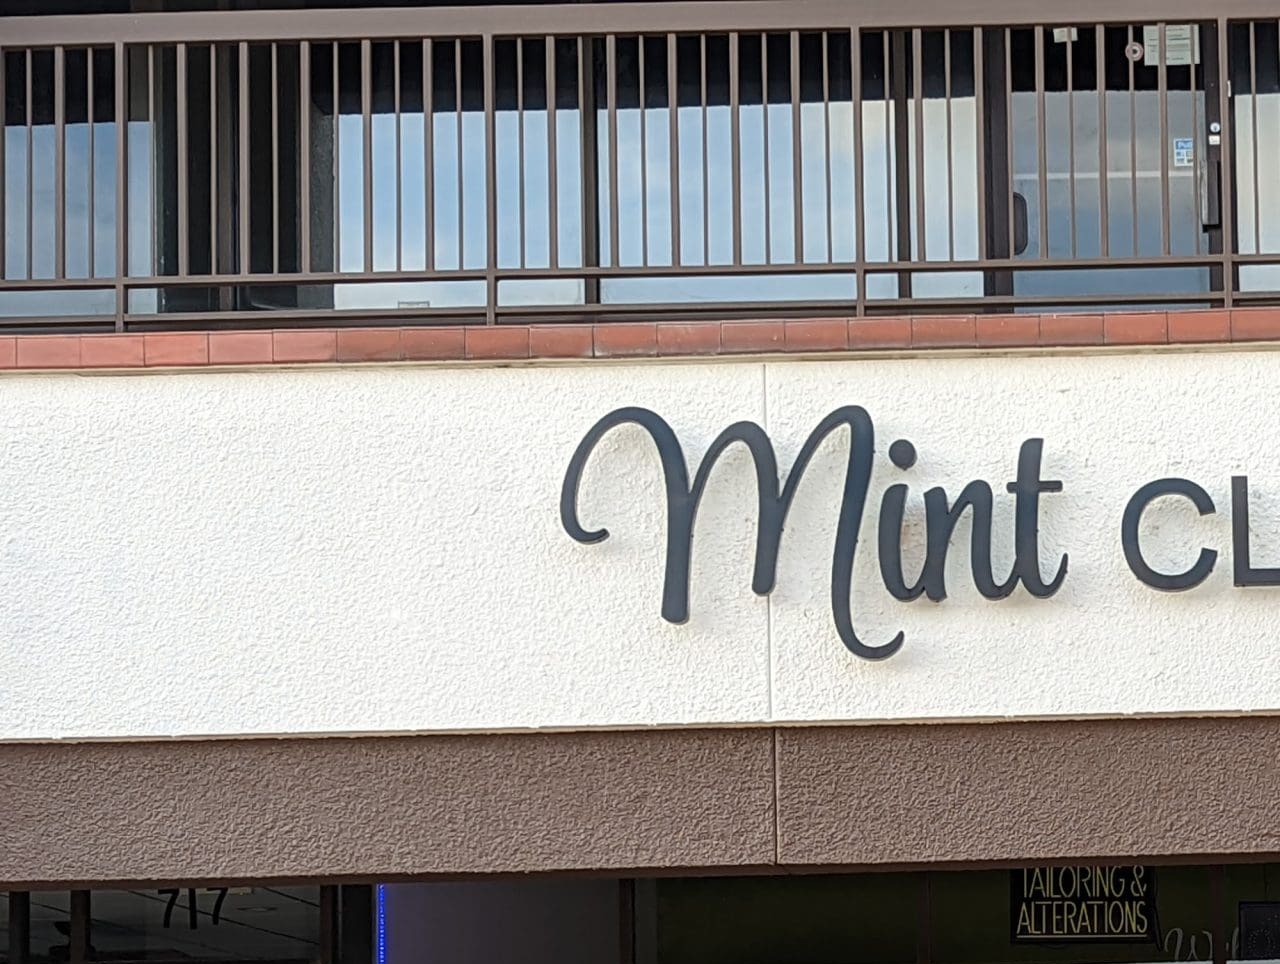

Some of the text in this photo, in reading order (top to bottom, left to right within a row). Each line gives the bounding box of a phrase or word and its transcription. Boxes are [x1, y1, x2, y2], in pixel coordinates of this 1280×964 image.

[560, 404, 1069, 661] Mint
[1023, 865, 1147, 898] TAILORING &
[158, 887, 228, 930] 717
[1016, 900, 1148, 935] ALTERATIONS
